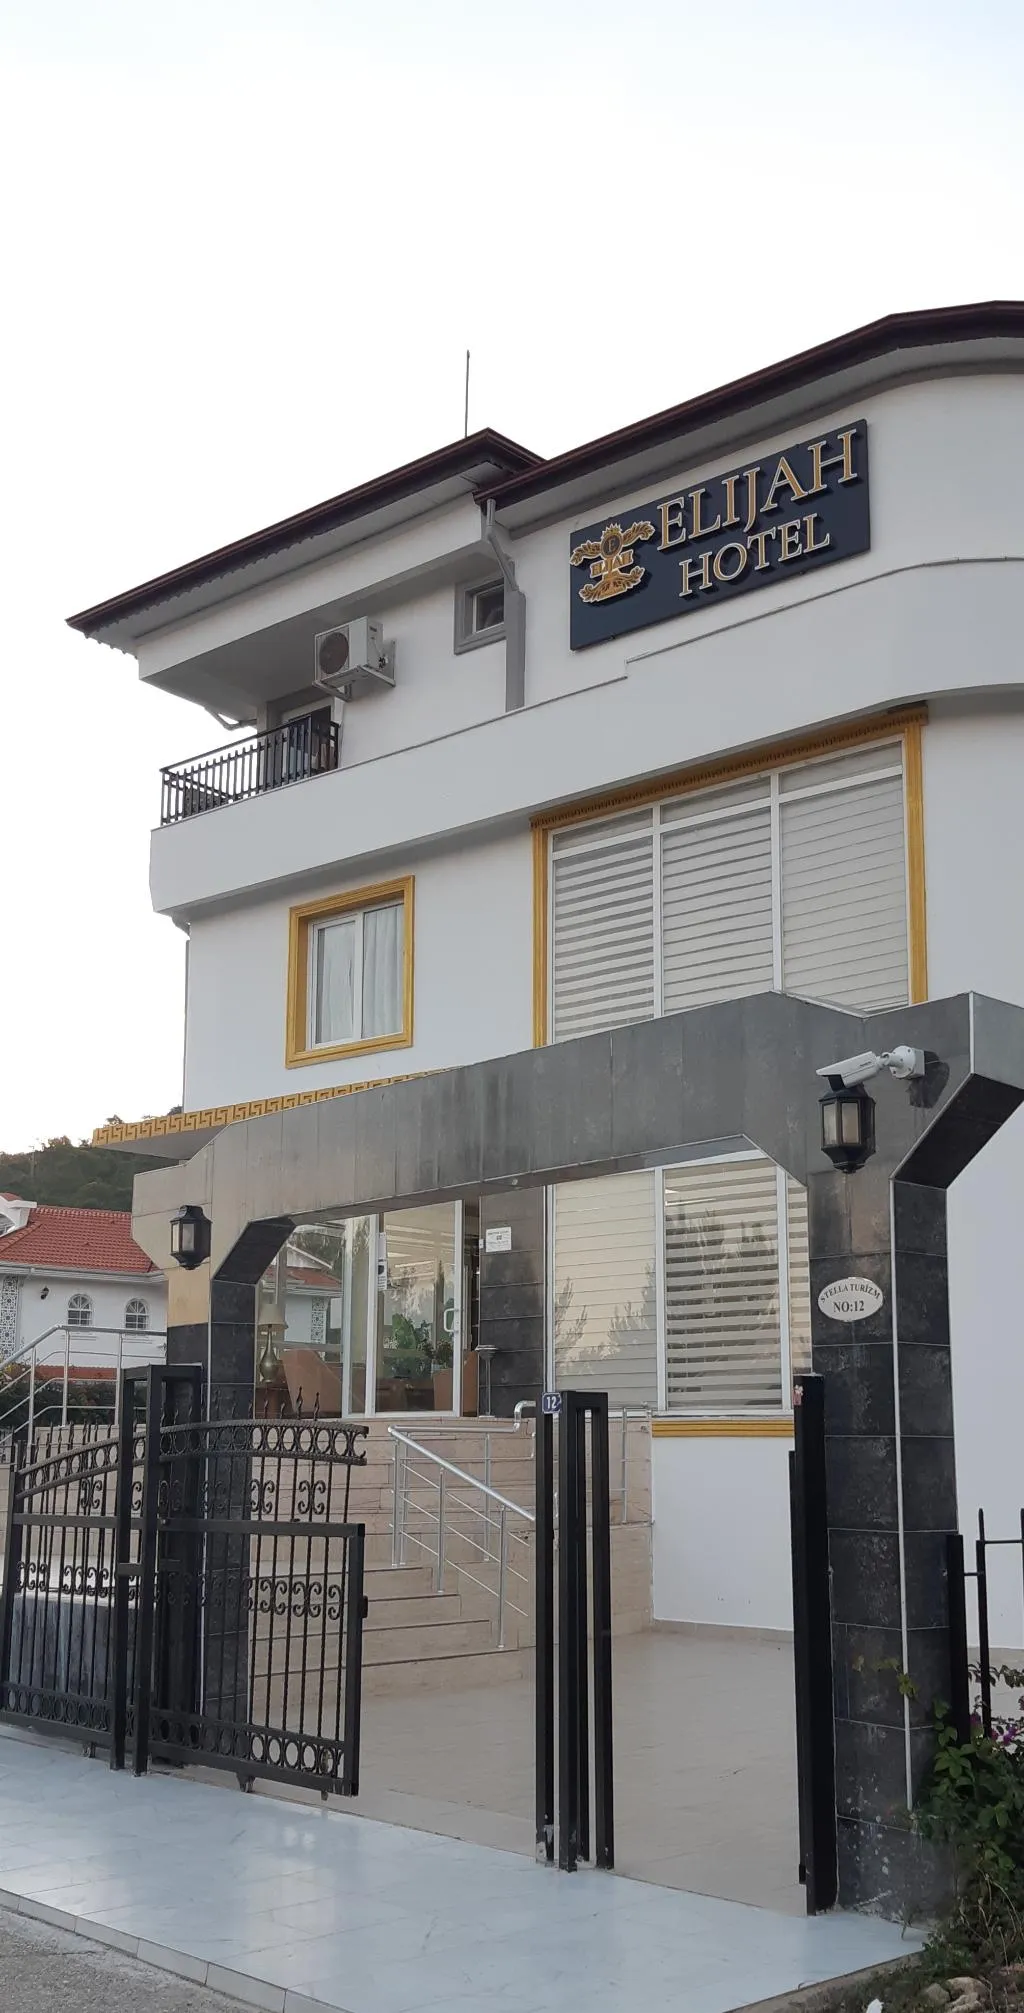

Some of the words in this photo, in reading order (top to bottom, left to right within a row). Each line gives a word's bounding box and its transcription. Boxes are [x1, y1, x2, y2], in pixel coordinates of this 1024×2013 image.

[657, 429, 857, 551] ELIJAH
[679, 513, 830, 597] HOTEL
[820, 1284, 849, 1303] STELLA
[833, 1300, 865, 1313] NO:12
[546, 1396, 557, 1409] 12
